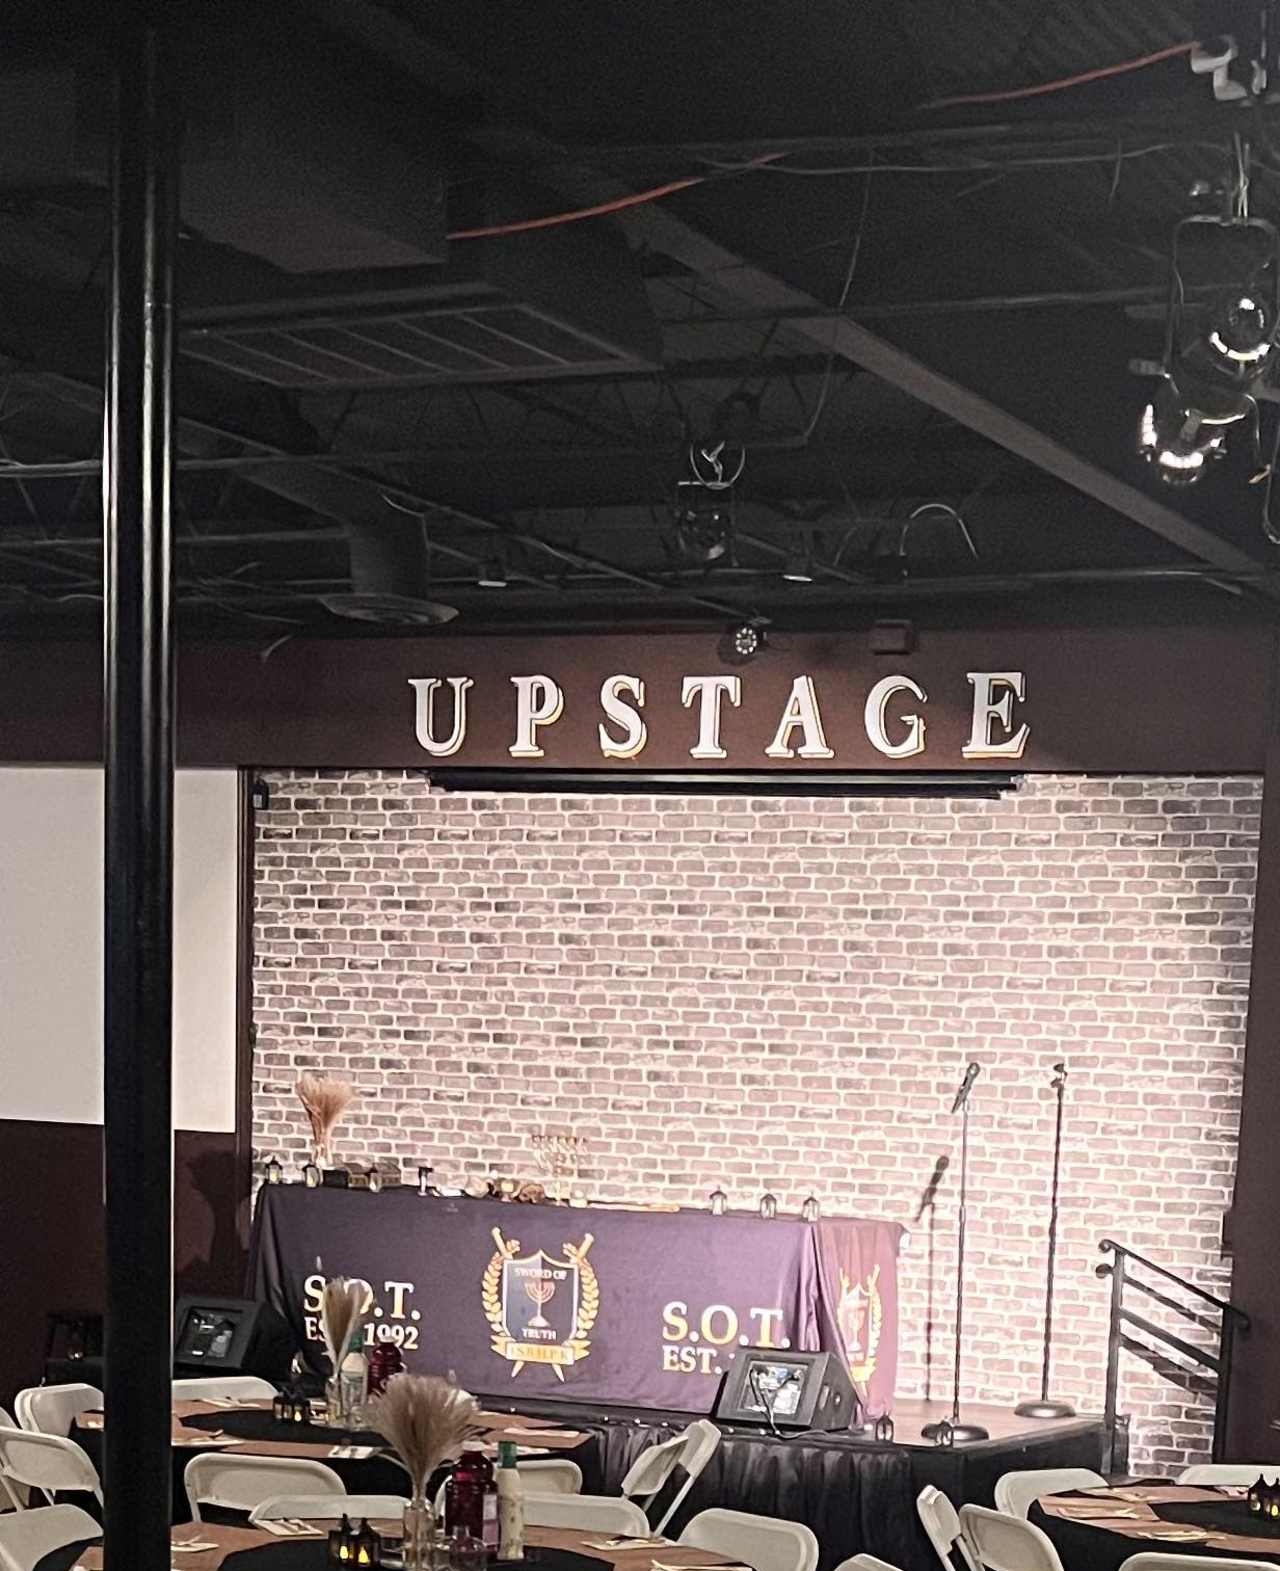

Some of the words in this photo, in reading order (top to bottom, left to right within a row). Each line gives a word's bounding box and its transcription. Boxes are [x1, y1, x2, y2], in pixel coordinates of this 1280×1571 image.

[407, 671, 1030, 759] UPSTAGE
[363, 1322, 419, 1350] 1992
[662, 1301, 791, 1348] S.O.T.
[662, 1345, 723, 1375] EST.
